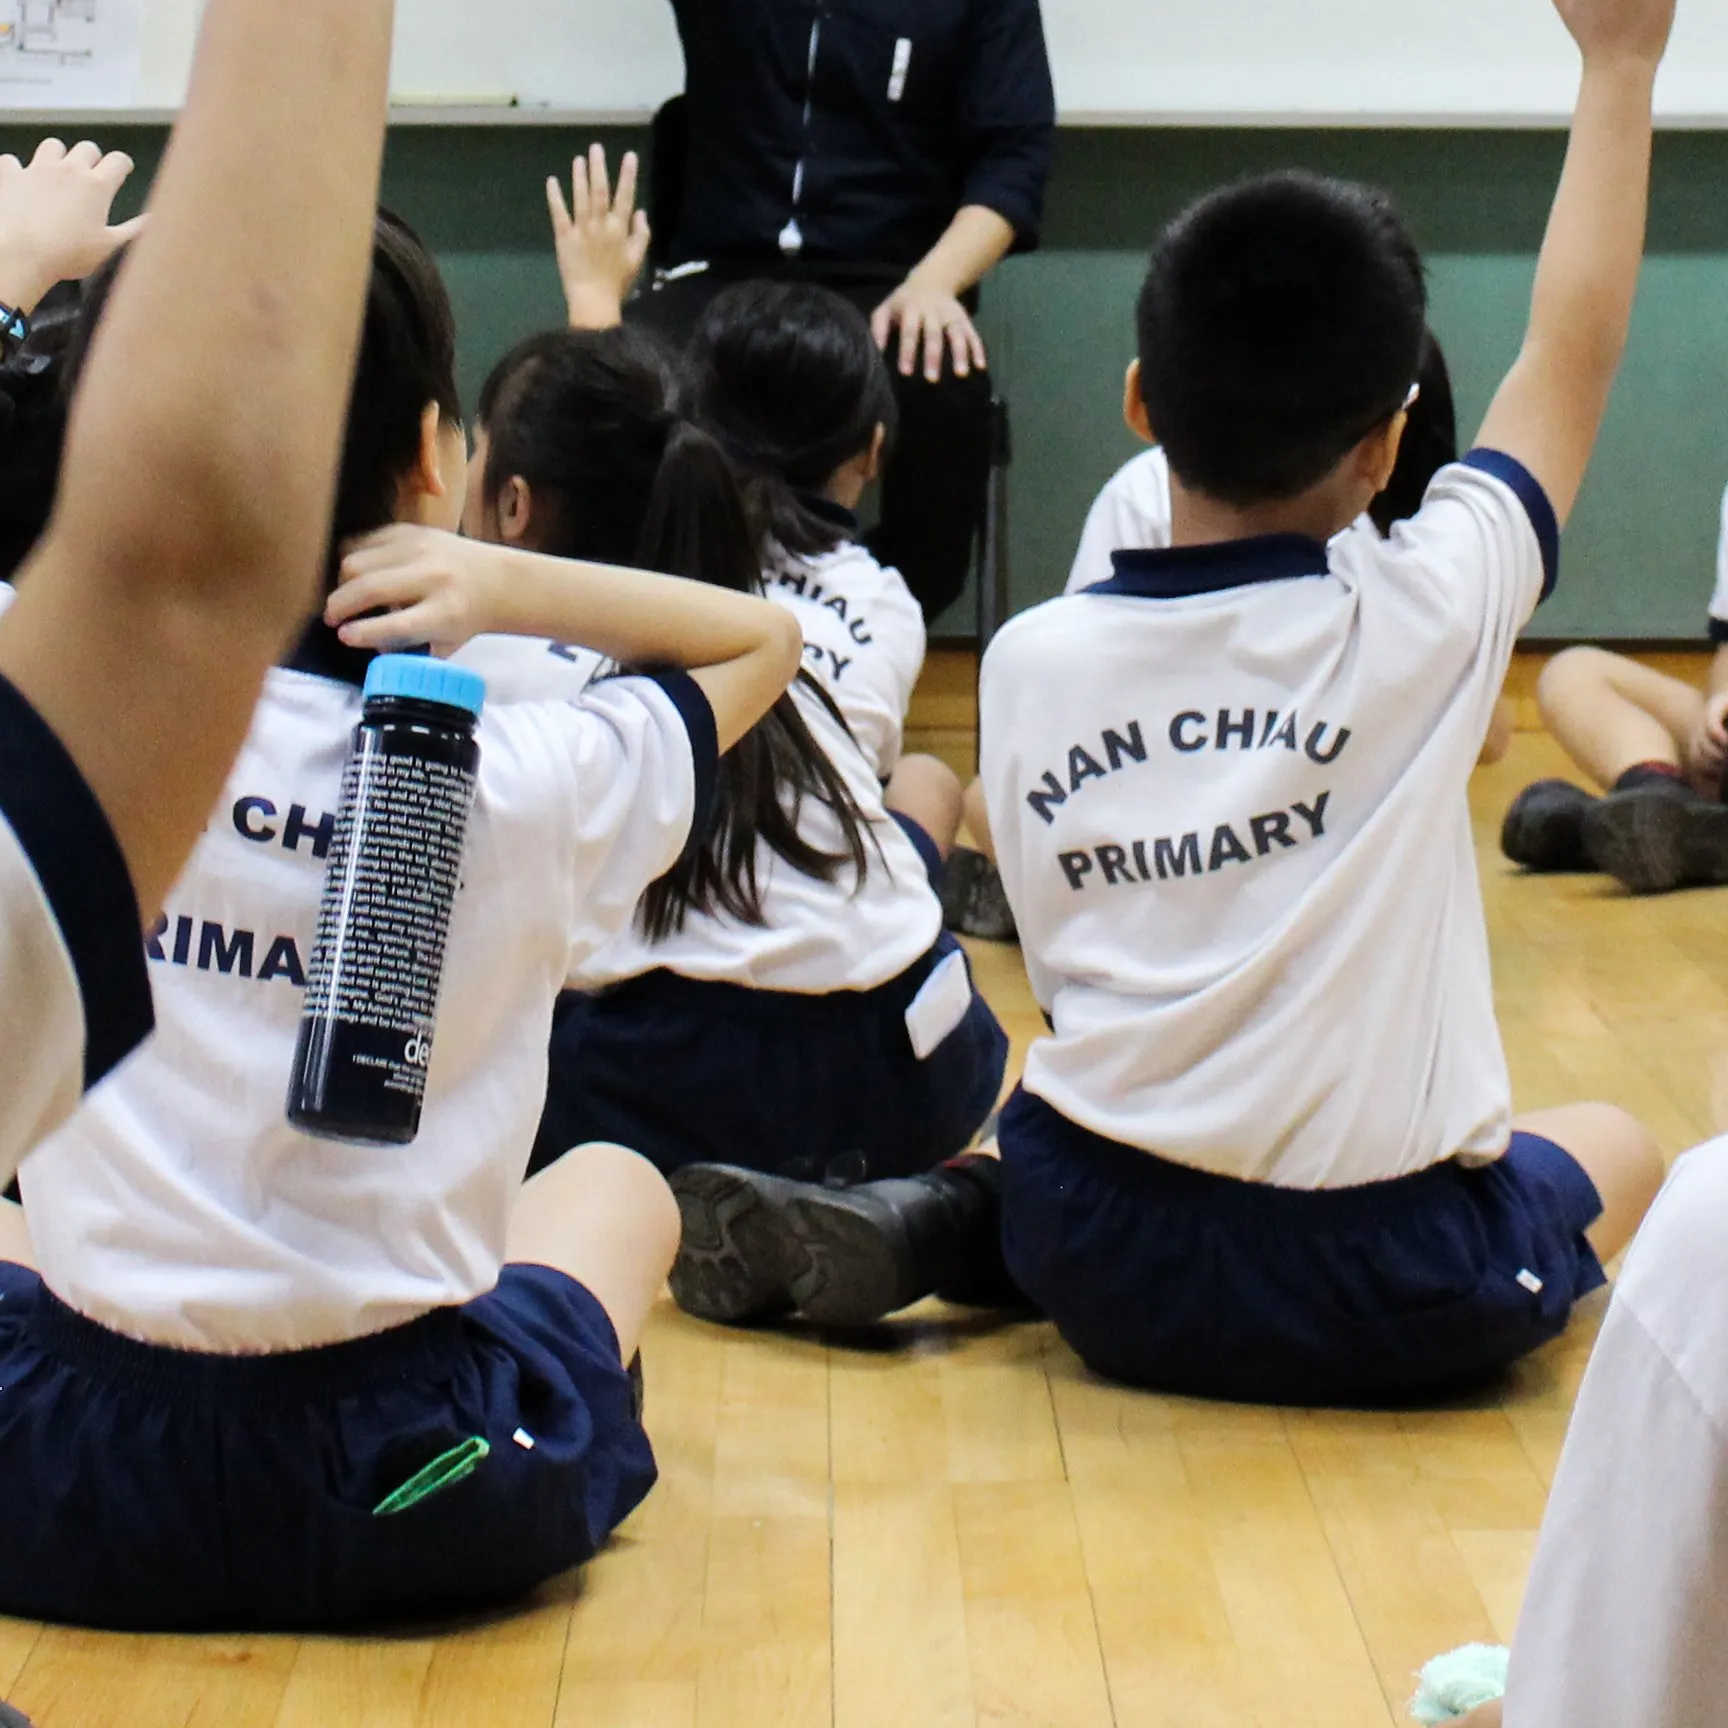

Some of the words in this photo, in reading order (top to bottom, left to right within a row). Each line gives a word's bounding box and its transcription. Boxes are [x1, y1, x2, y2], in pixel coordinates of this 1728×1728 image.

[766, 571, 873, 646] HIAU
[1026, 719, 1148, 825] NAN
[1168, 708, 1352, 766] CHIAU
[1057, 789, 1331, 891] PRIMARY
